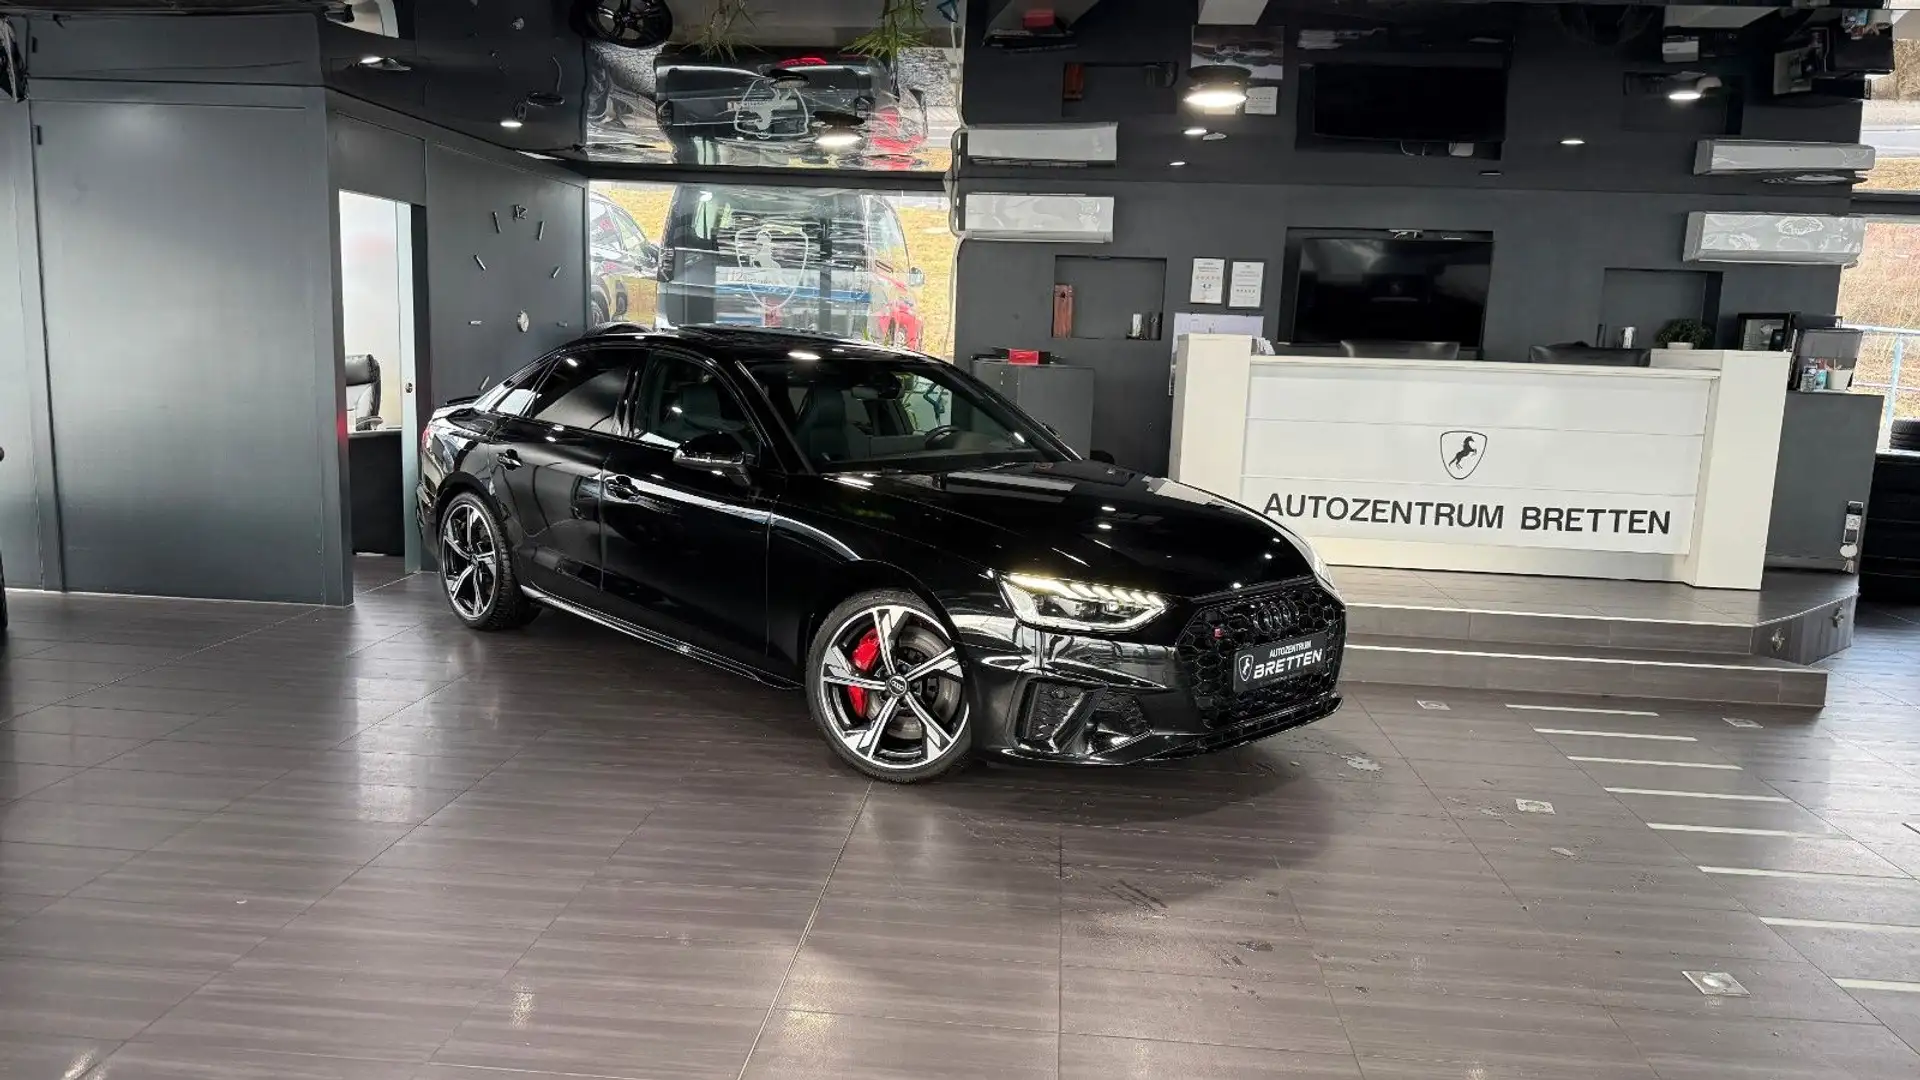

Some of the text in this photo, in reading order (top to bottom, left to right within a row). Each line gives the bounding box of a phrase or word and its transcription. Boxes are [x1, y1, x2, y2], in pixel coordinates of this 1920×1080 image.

[1263, 493, 1671, 534] AUTOZENTRUM BRETTEN
[1253, 648, 1323, 679] BRETTEN
[1269, 640, 1312, 658] AUTOZENTRUM
